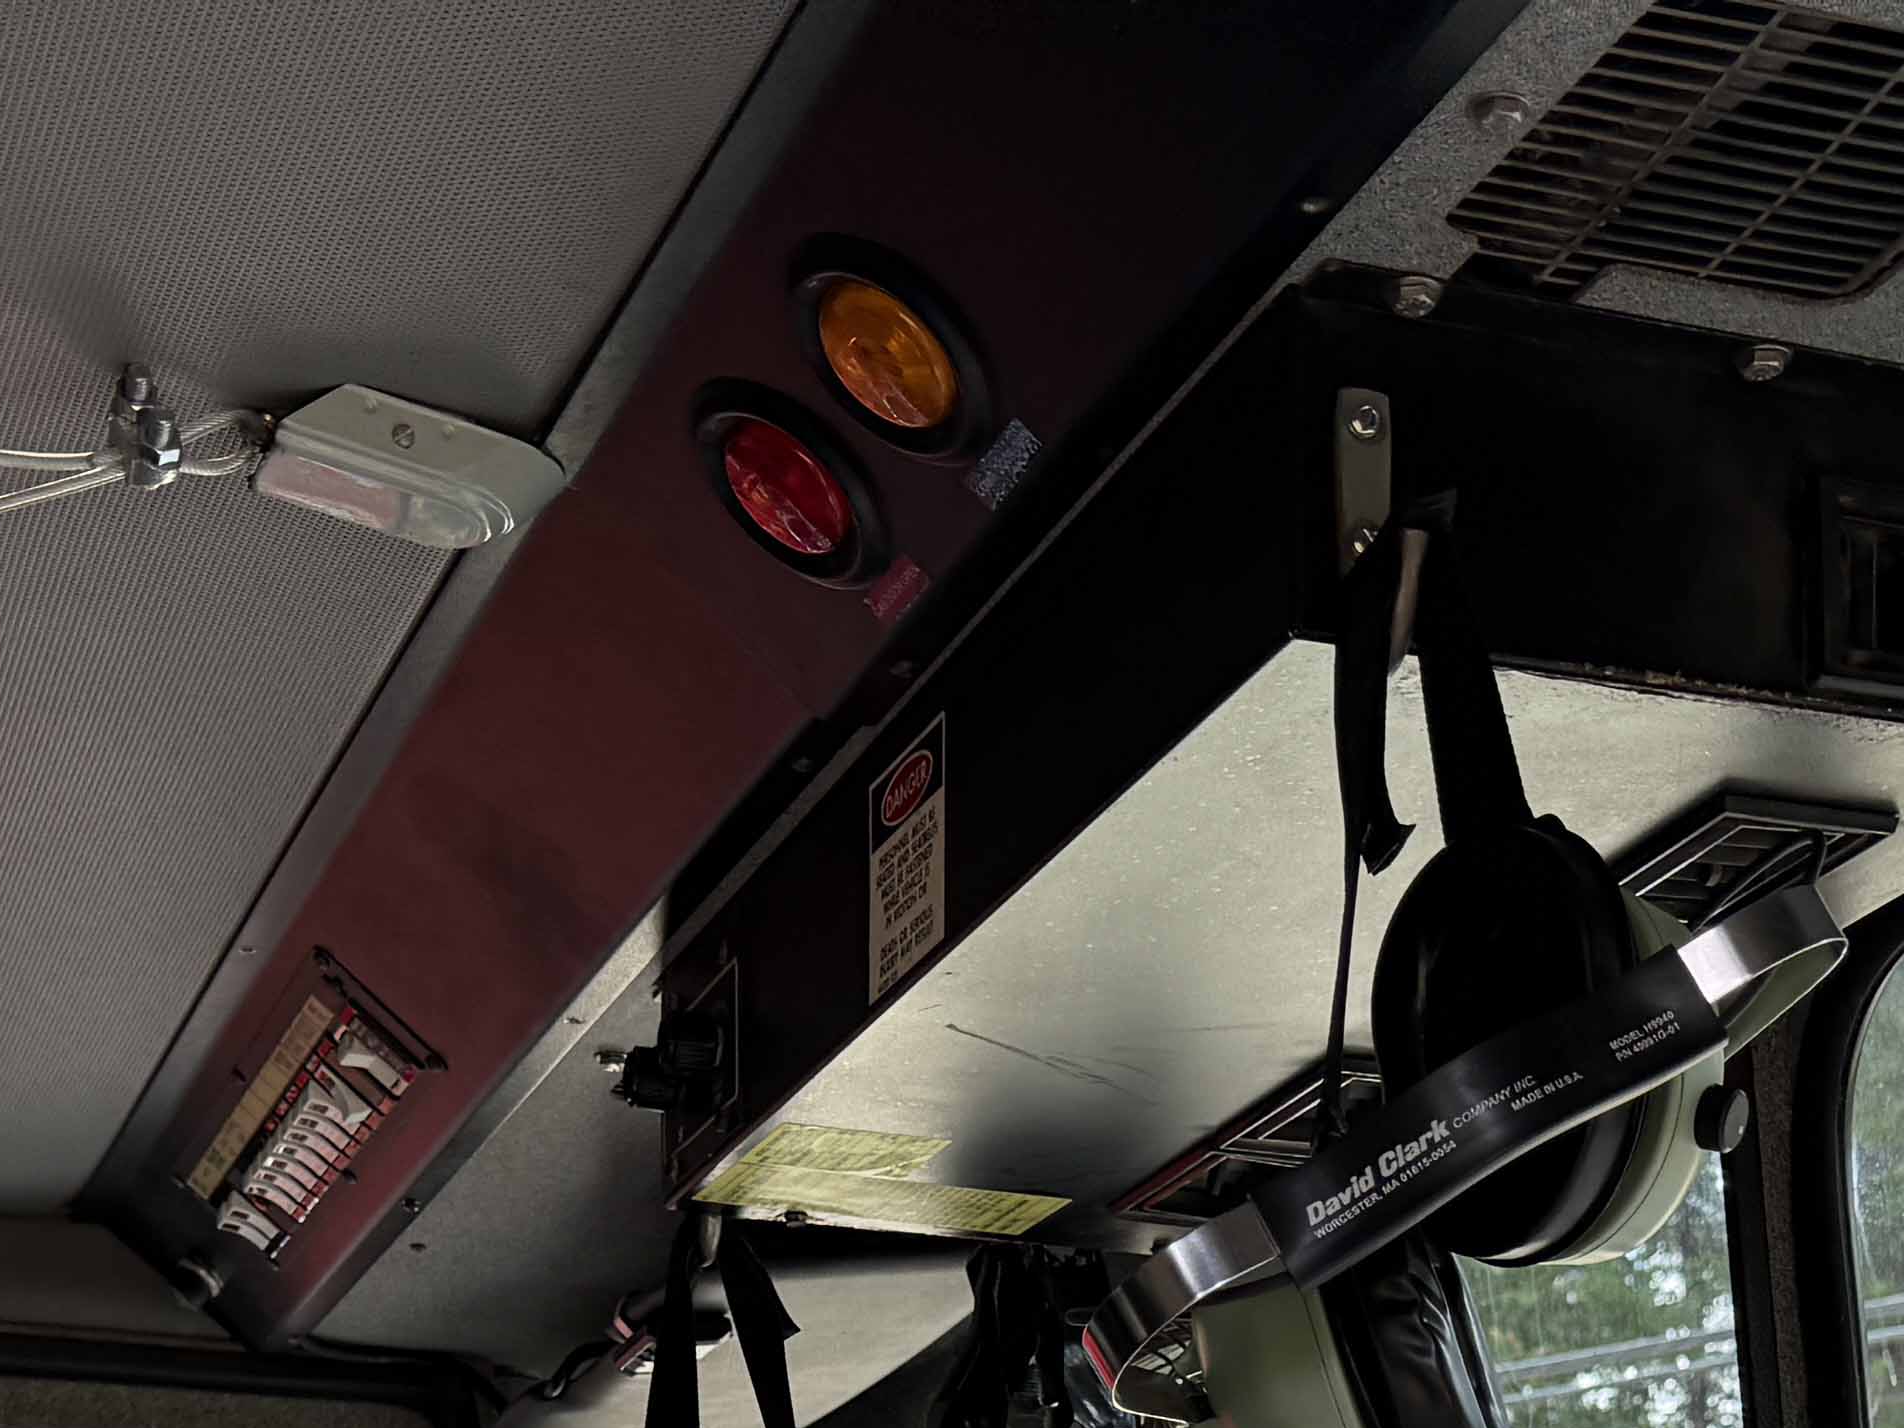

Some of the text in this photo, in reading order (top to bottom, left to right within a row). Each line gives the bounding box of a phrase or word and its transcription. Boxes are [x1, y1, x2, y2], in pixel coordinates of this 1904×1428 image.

[885, 760, 928, 819] DANGER
[1609, 1029, 1644, 1050] MODEL
[1510, 1088, 1544, 1112] MADE
[1544, 1083, 1556, 1095] IN
[1306, 1165, 1375, 1226] David
[1378, 1119, 1451, 1178] Clark
[1452, 1085, 1511, 1128] COMPANY
[1382, 1177, 1401, 1196] MA
